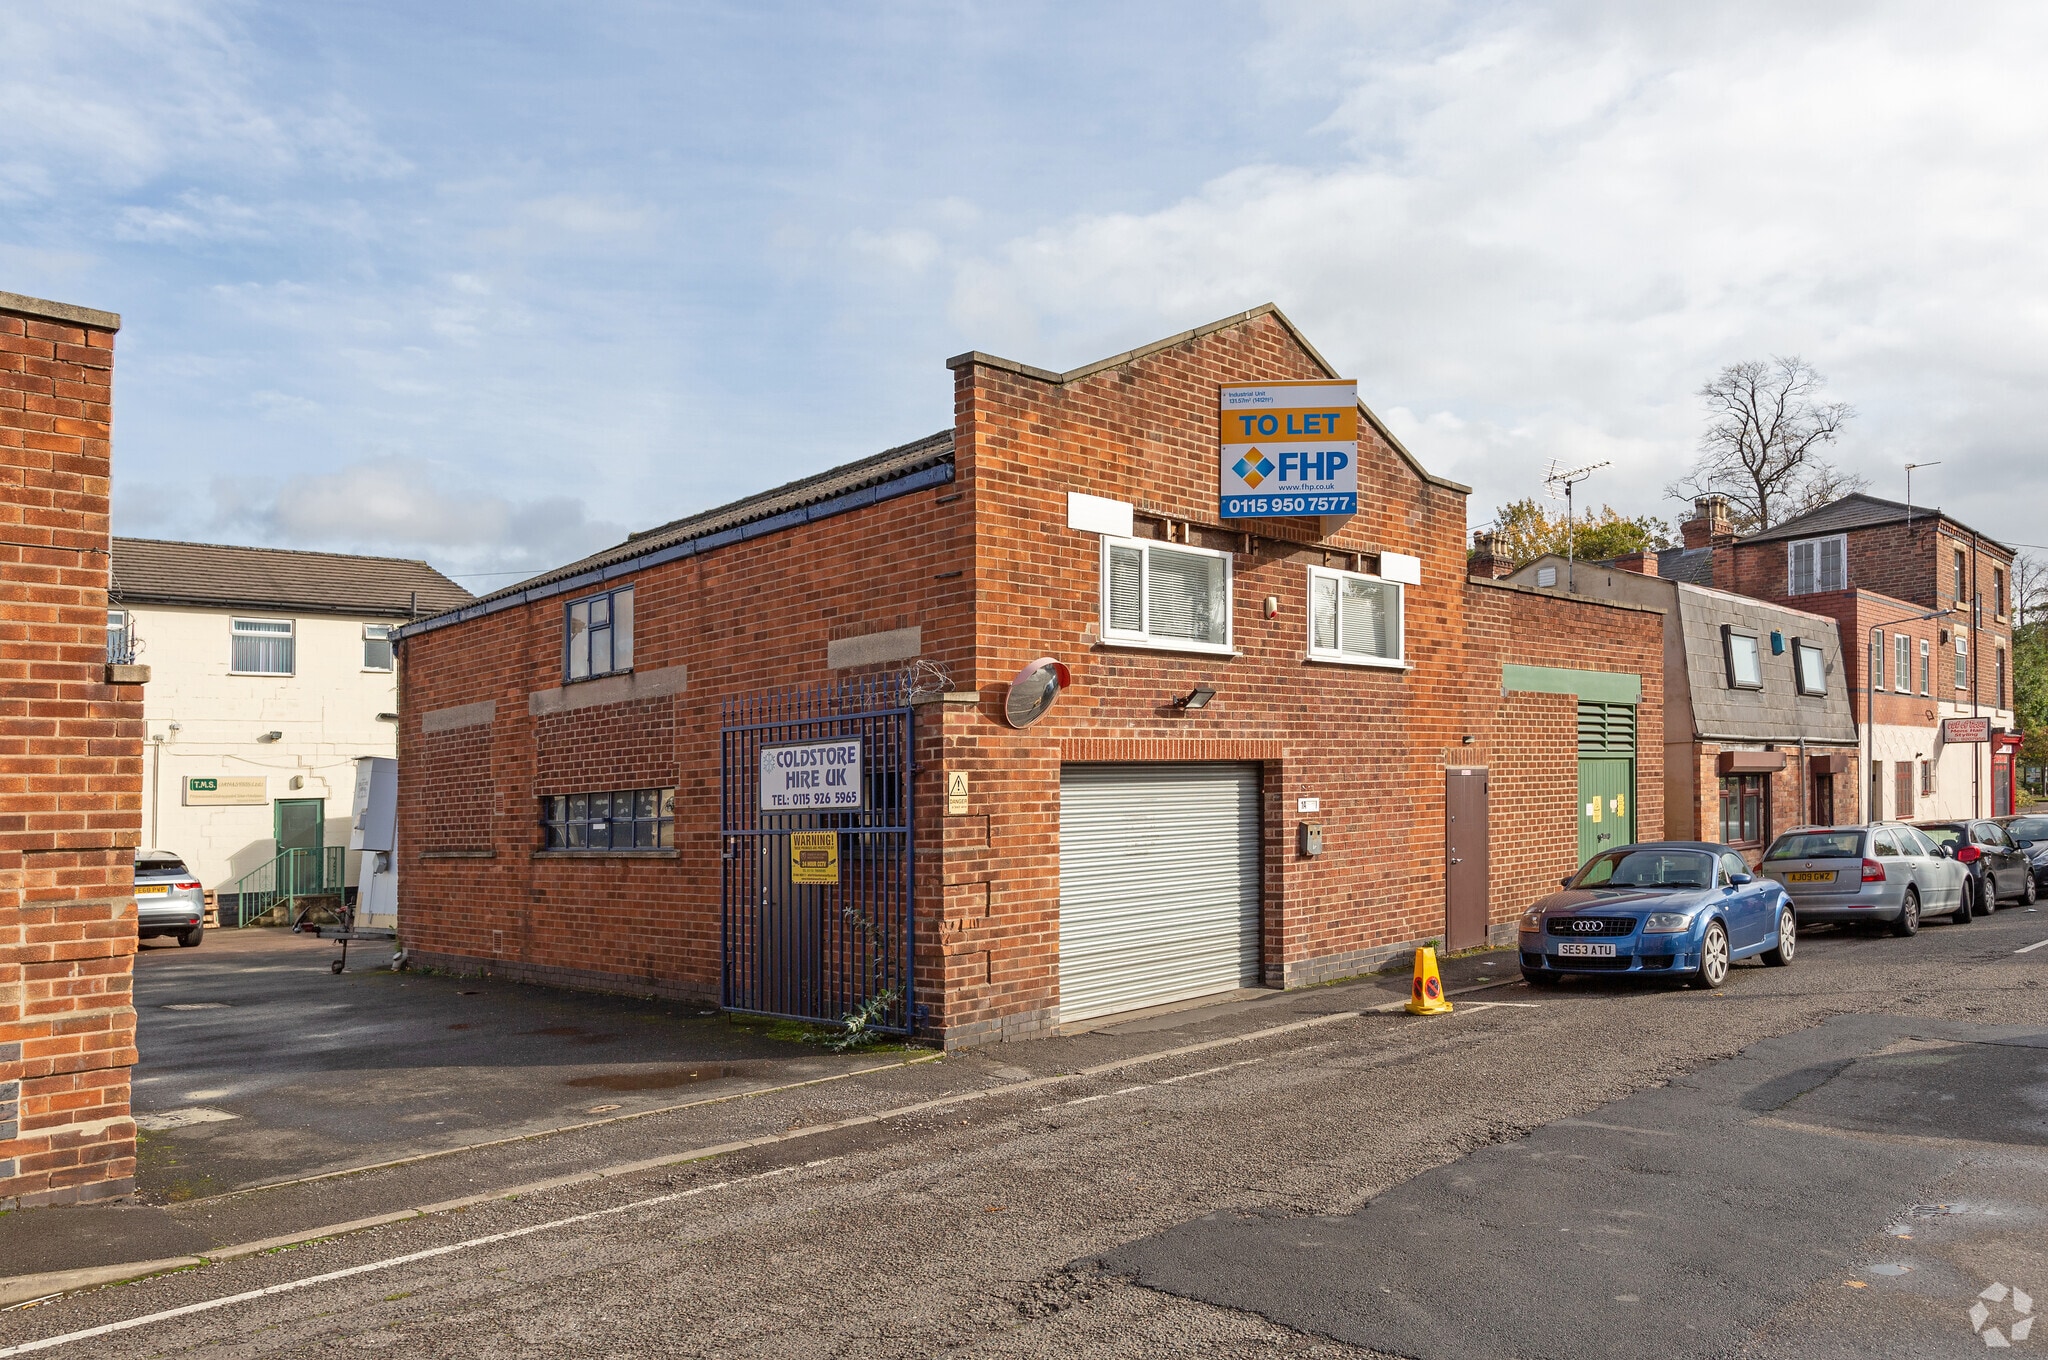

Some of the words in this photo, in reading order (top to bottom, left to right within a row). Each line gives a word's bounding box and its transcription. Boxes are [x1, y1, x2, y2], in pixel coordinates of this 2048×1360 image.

[1239, 414, 1279, 436] TO
[1287, 413, 1341, 435] LET
[1278, 451, 1349, 482] FHP
[1278, 483, 1335, 492] www.fhp.co.uk
[1228, 498, 1268, 513] 0115
[1271, 497, 1305, 512] 950
[1309, 496, 1350, 511] 7577
[776, 745, 856, 768] COLDSTORE
[194, 780, 216, 789] T.M.S.
[785, 769, 820, 790] HIRE
[825, 768, 847, 787] UK
[772, 794, 790, 806] TEL:
[792, 793, 811, 805] 0115
[814, 792, 831, 805] 926
[835, 791, 857, 804] 5965
[793, 834, 834, 846] WARNING!
[1791, 873, 1812, 881] AJ09
[1814, 872, 1831, 881] GWZ
[1562, 945, 1588, 955] SE53
[1591, 945, 1612, 955] ATU
